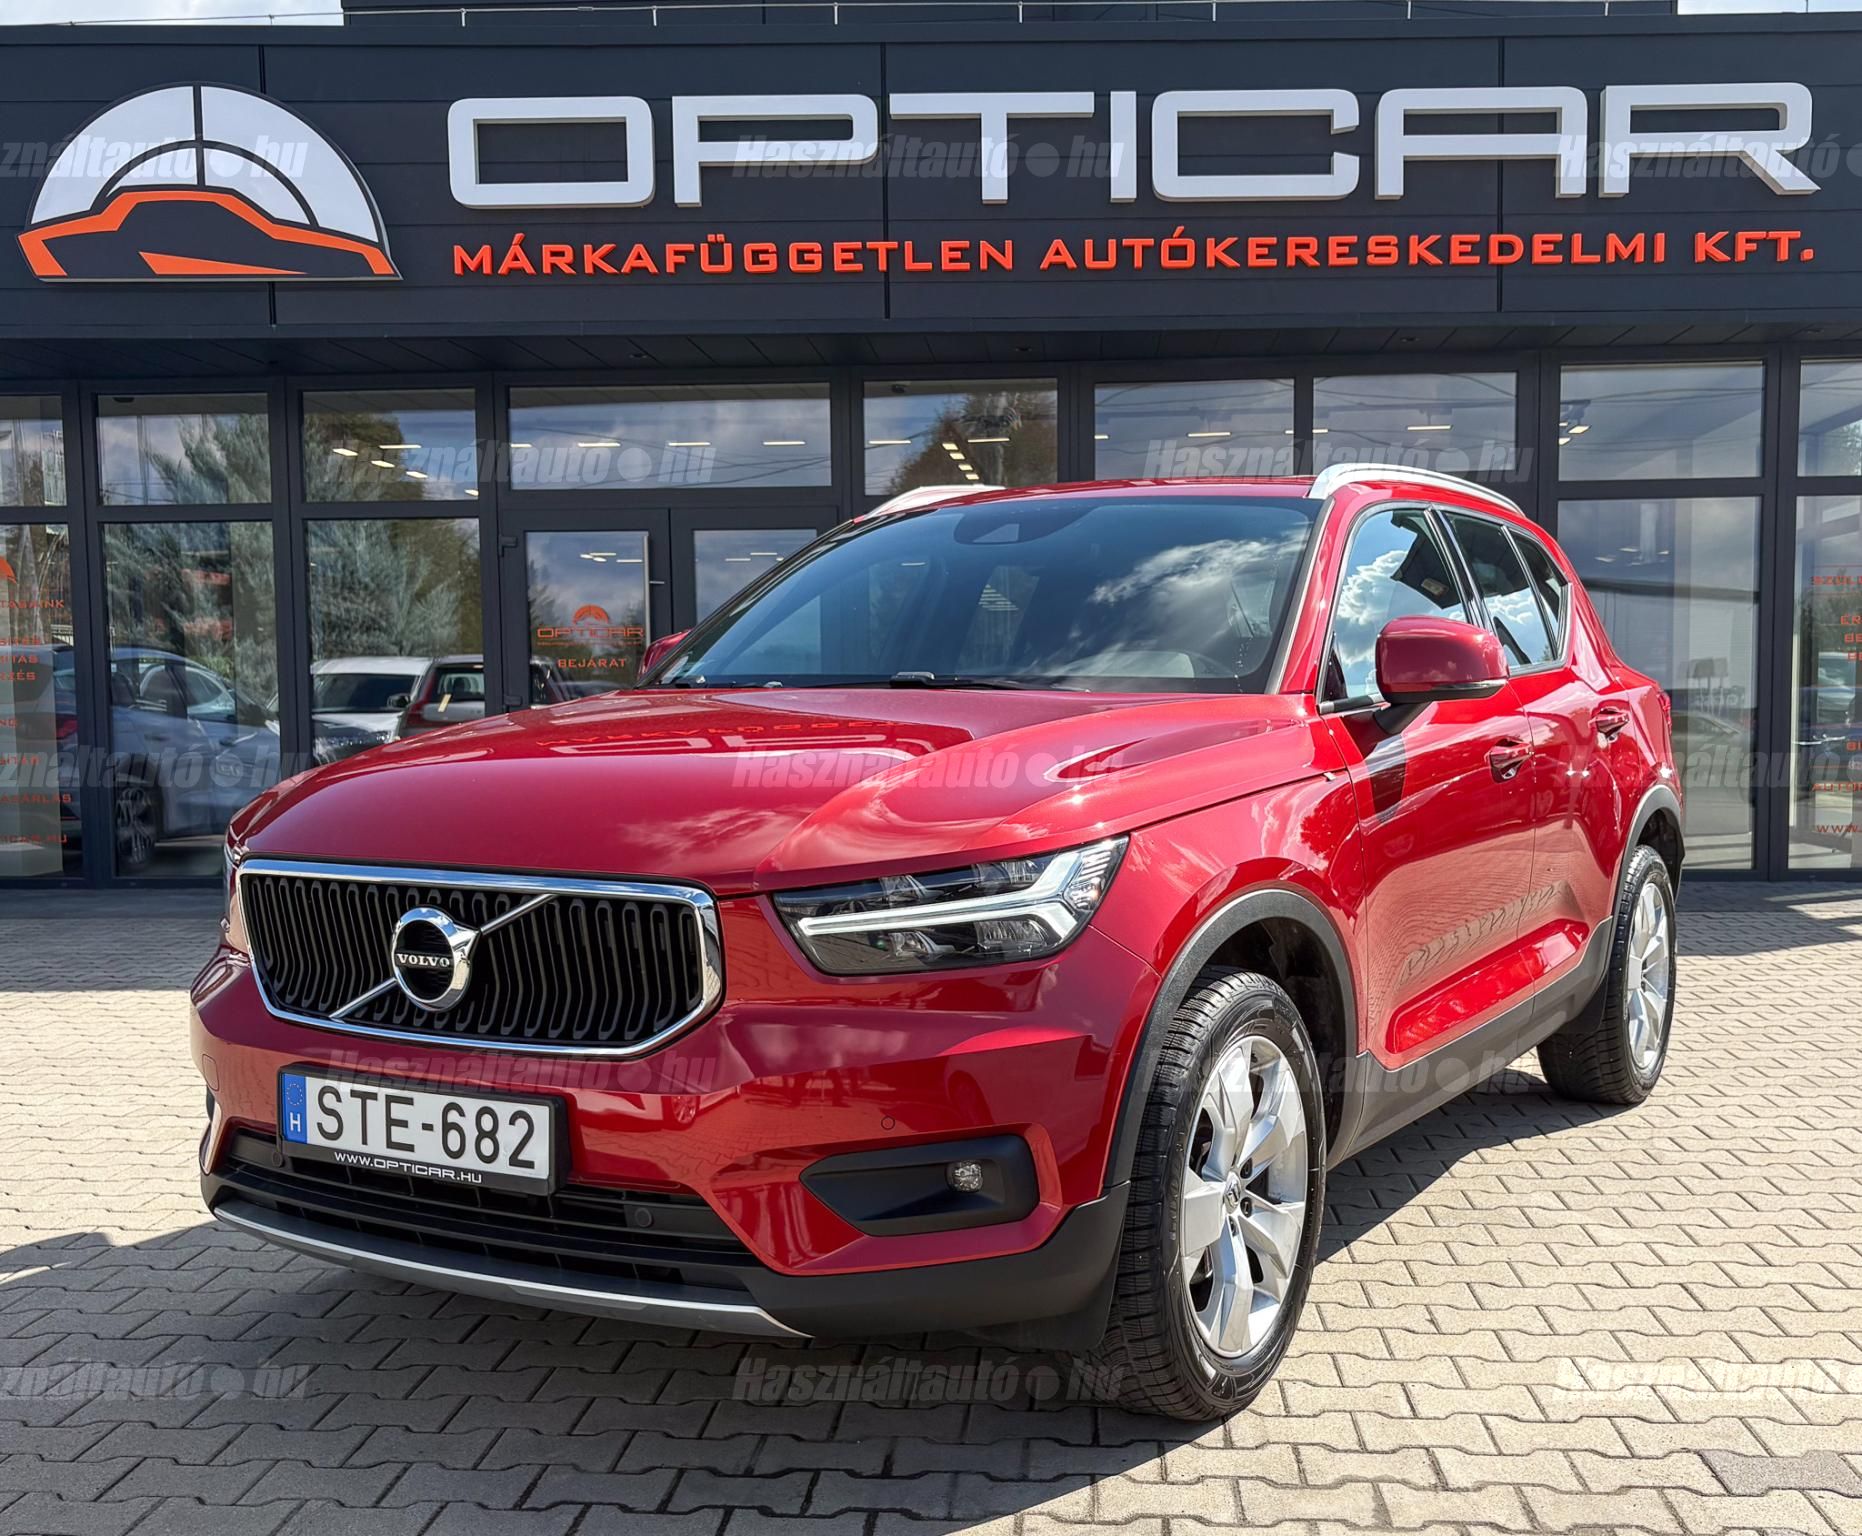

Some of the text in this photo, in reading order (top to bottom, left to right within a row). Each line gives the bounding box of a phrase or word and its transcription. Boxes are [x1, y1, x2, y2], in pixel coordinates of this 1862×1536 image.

[447, 82, 1821, 208] OPTICAR
[453, 225, 1815, 276] MÁRKAFÜGGETLEN AUTÓKERESKEDELMI KFT.
[557, 654, 626, 669] BEJÁRAT
[397, 953, 450, 967] VOLVO
[290, 1111, 301, 1133] H
[316, 1085, 536, 1170] STE-682
[334, 1151, 483, 1184] WWW.OPTICAR.HU
